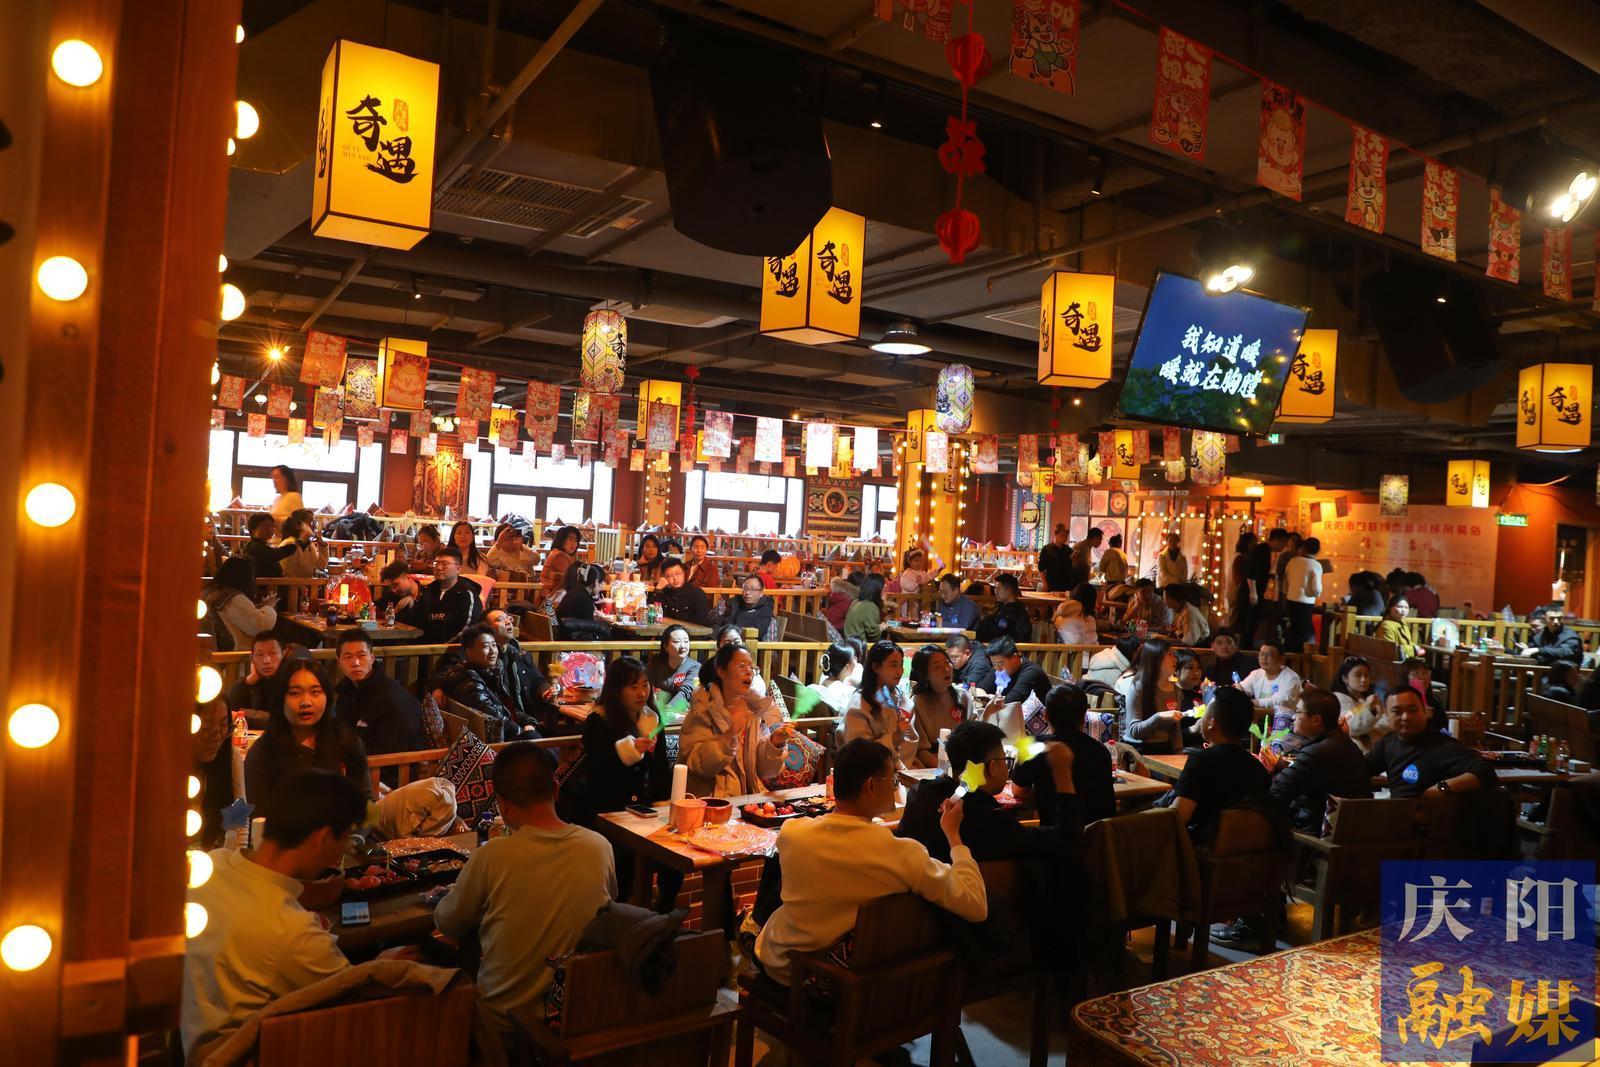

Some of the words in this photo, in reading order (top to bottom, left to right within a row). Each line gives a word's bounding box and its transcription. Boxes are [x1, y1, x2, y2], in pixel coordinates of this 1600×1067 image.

[345, 94, 419, 184] 奇遇
[816, 240, 853, 305] 奇遇
[1060, 301, 1103, 353] 奇遇
[1181, 324, 1261, 368] 我知道暖
[1159, 354, 1264, 399] 暖就在胸膛
[1291, 353, 1327, 395] 奇遇
[1547, 386, 1583, 426] 奇遇
[1402, 769, 1418, 781] 003
